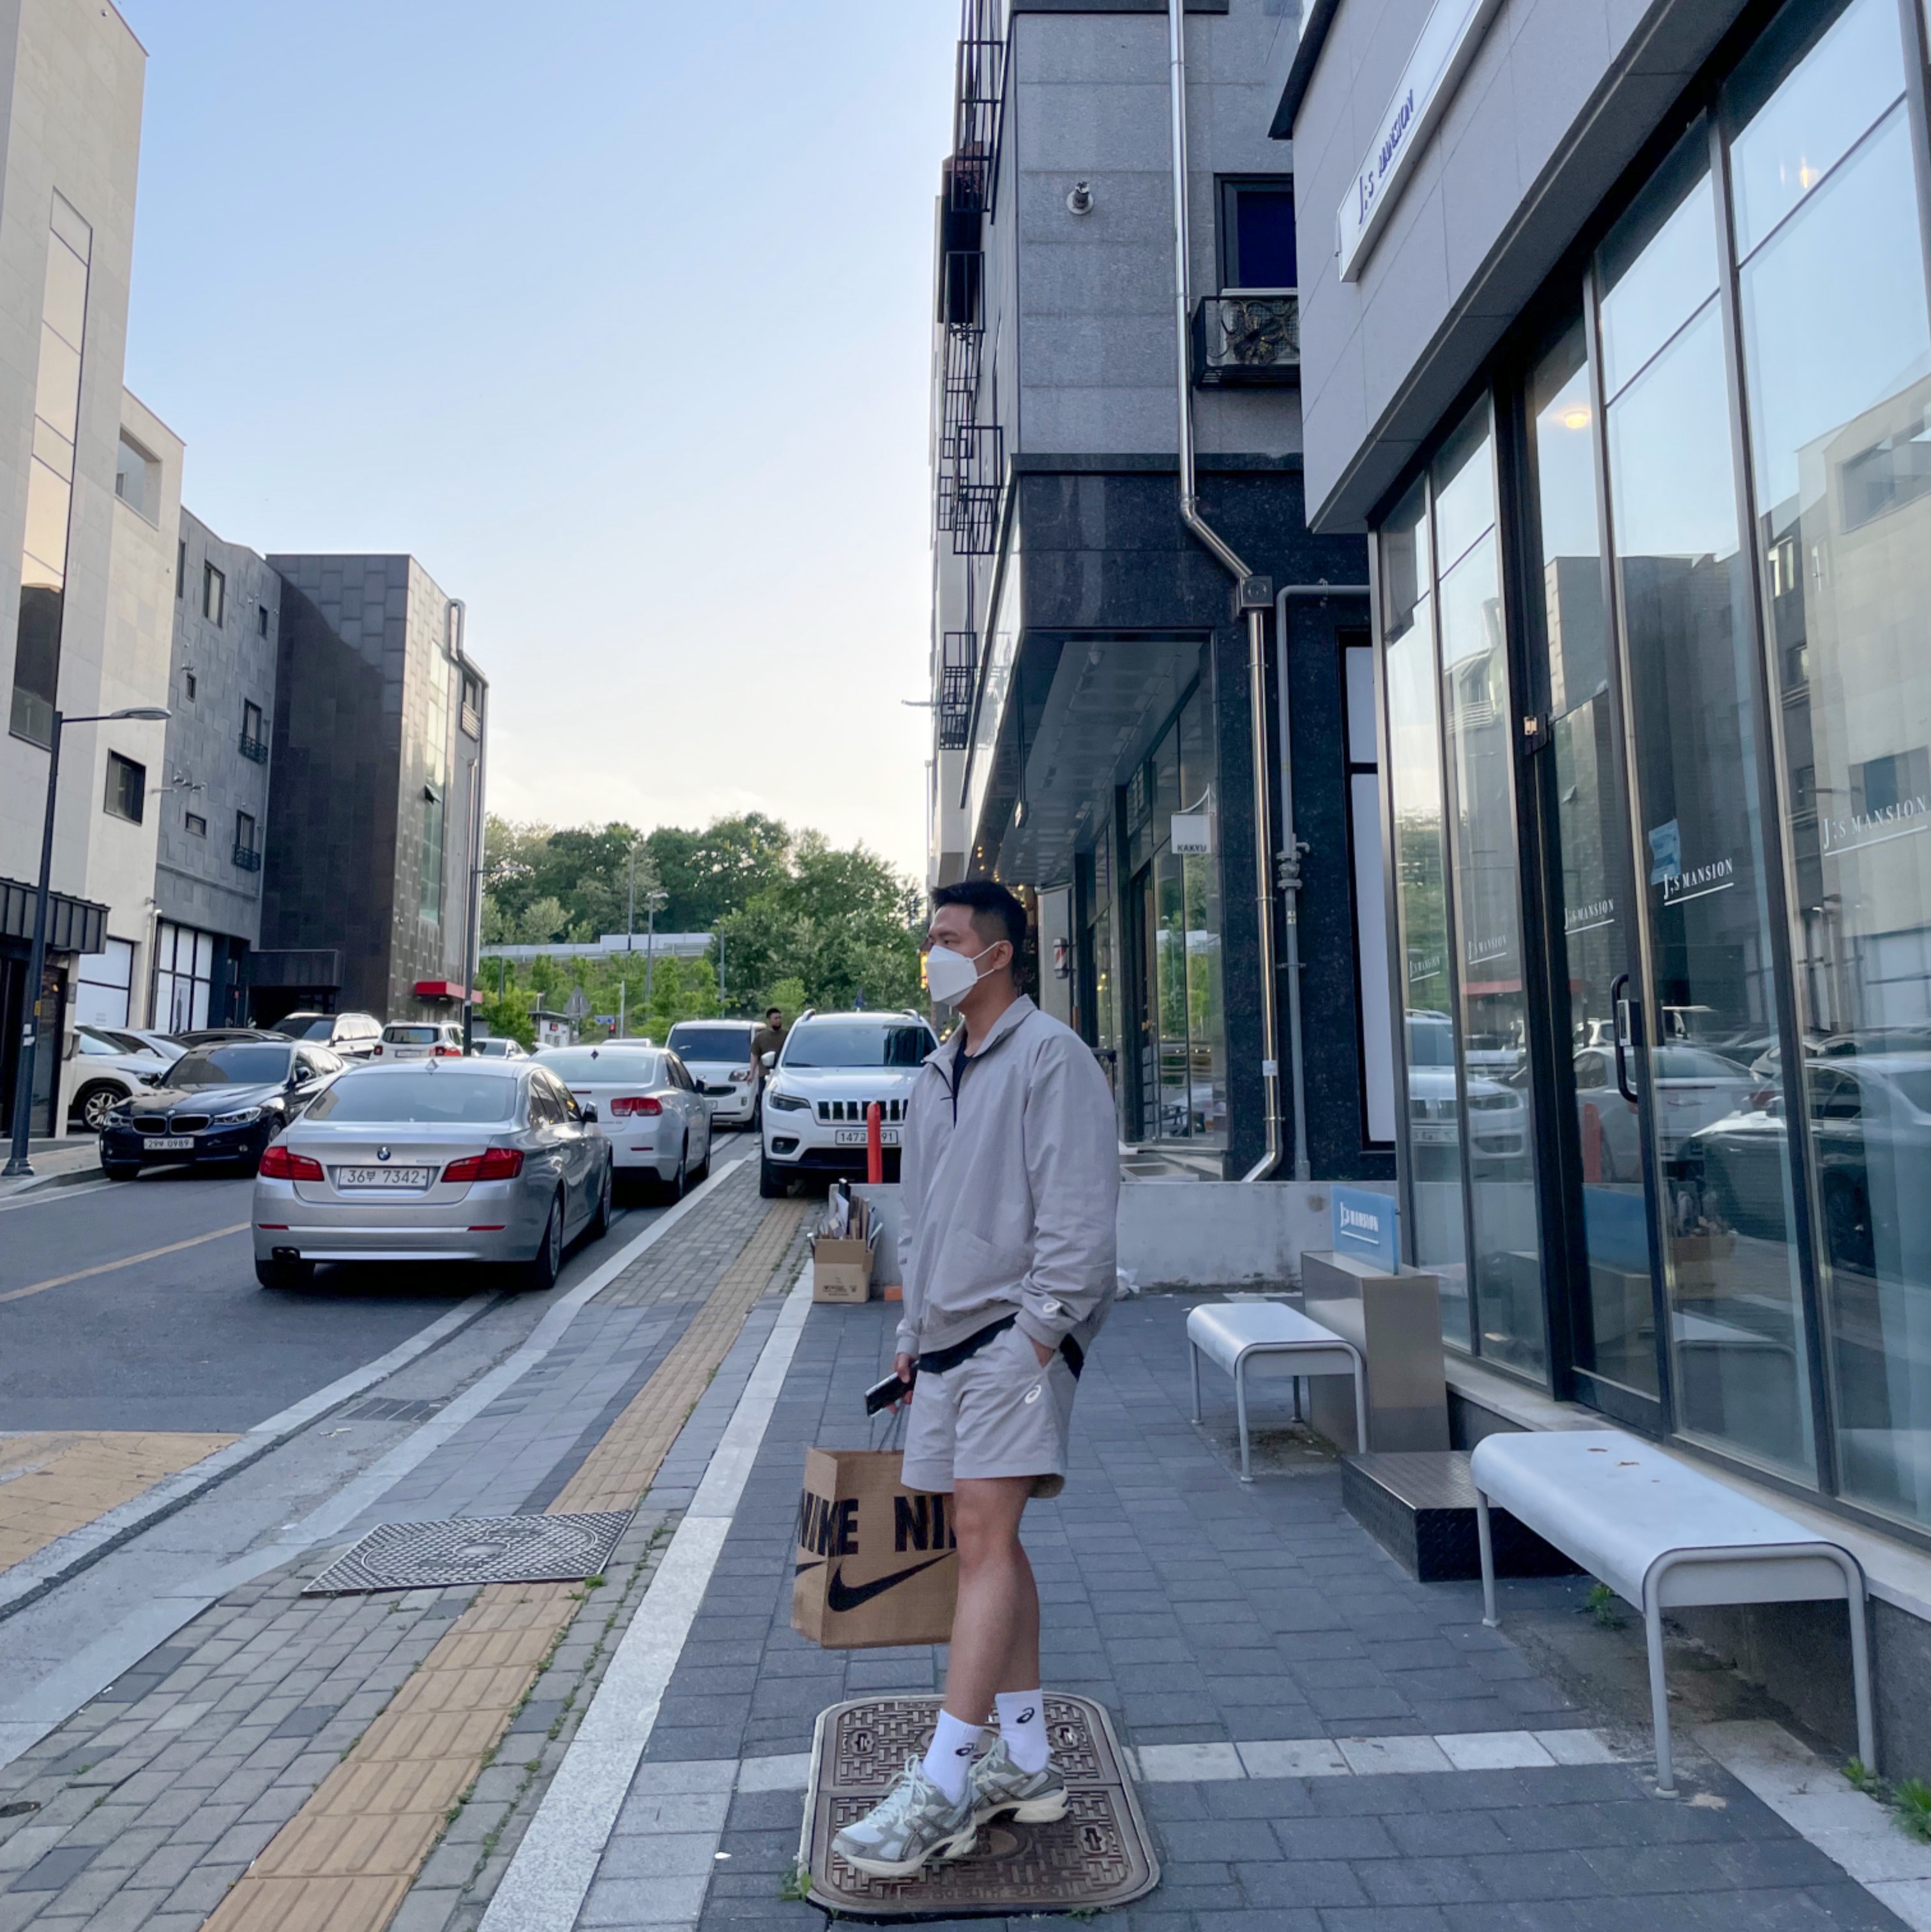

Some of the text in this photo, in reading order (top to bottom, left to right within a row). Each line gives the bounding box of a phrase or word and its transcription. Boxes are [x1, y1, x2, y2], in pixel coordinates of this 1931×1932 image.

[1378, 88, 1414, 179] MANSION
[1851, 795, 1926, 835] MANSION
[1177, 844, 1207, 852] KAKYU
[1682, 858, 1733, 888] MANSION
[1577, 899, 1614, 921] MANSION
[167, 1139, 190, 1148] 0989
[347, 1169, 420, 1183] 36부 7342
[798, 1489, 957, 1557] NIKE NI
